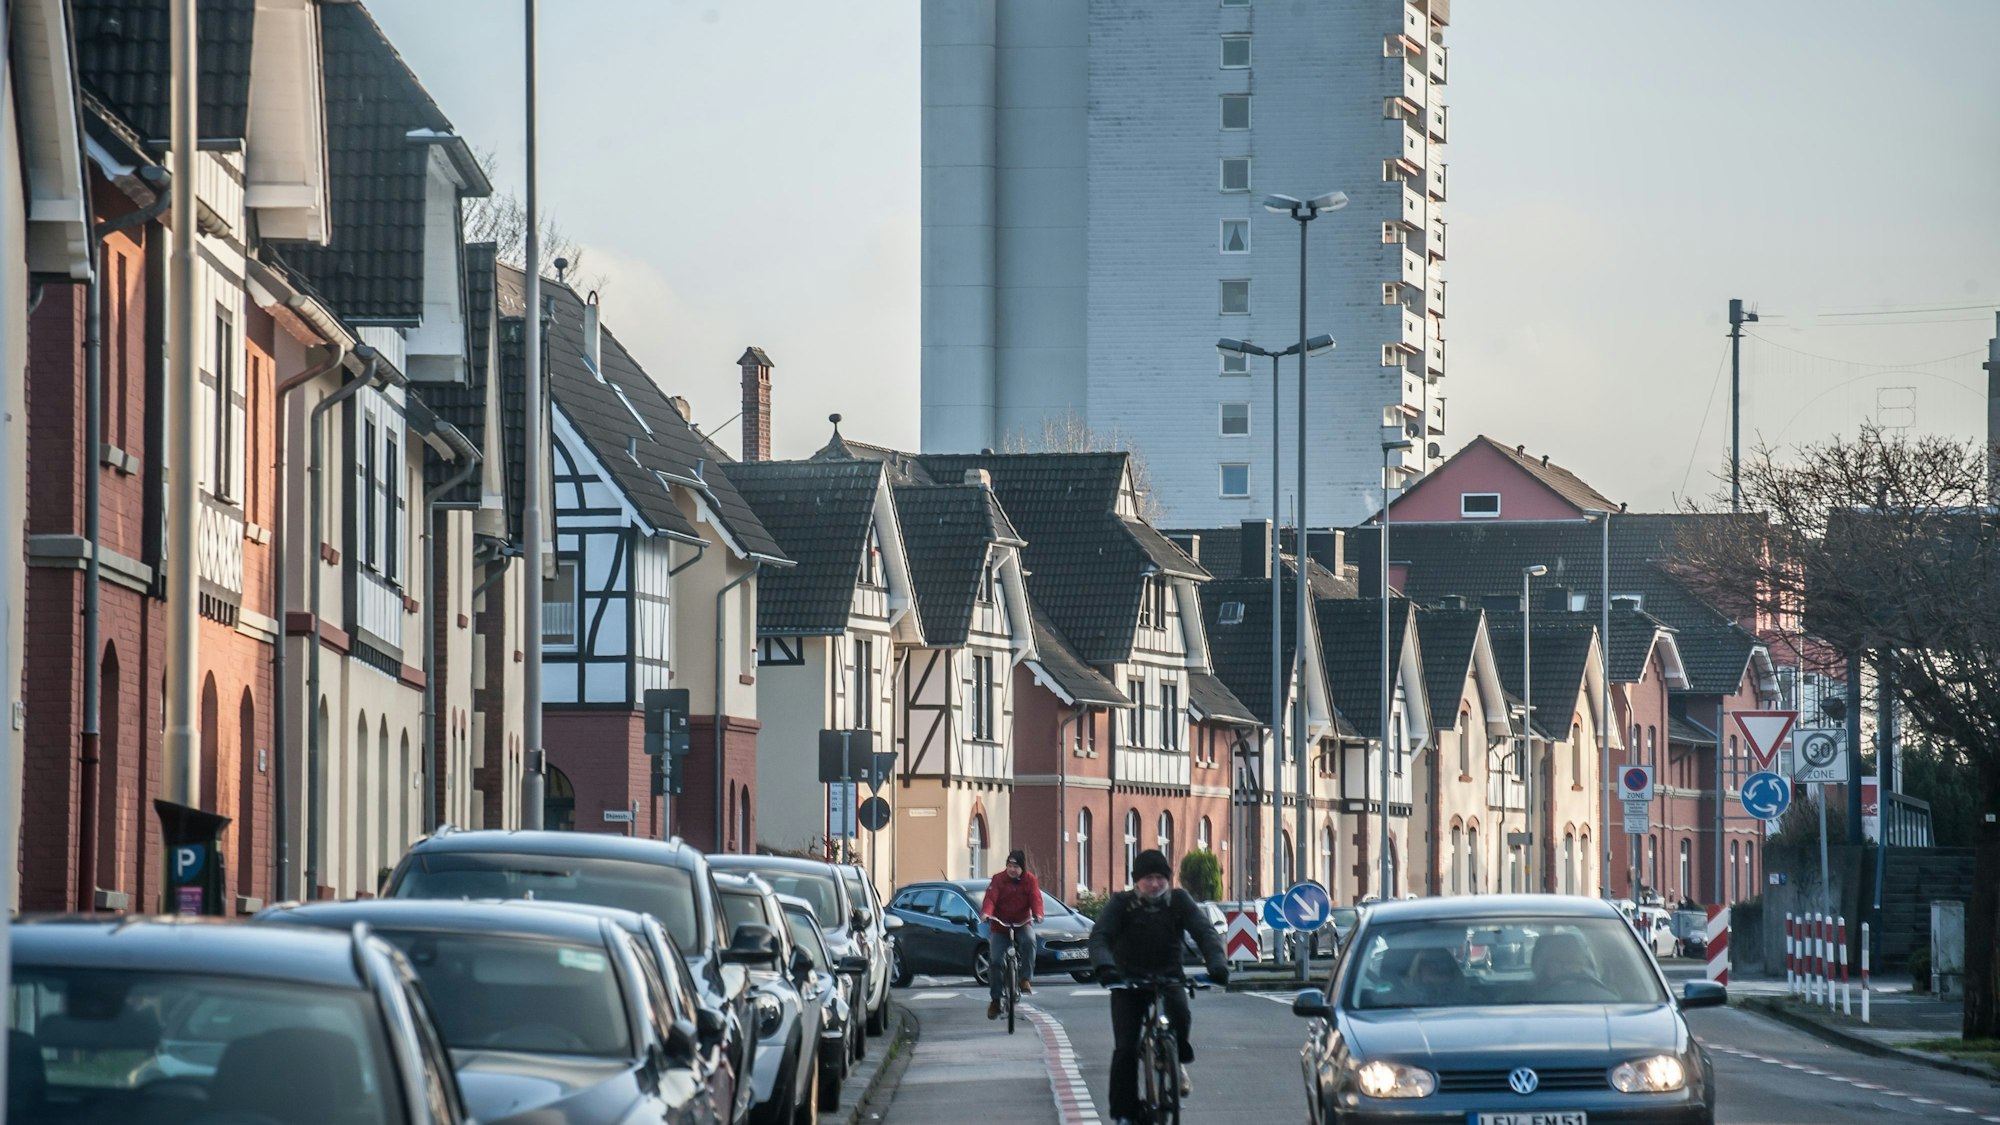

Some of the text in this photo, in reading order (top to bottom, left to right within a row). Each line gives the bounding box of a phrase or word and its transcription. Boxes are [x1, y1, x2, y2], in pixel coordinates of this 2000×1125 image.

[1809, 742, 1831, 759] 30
[1807, 769, 1835, 779] ZONE
[1626, 792, 1645, 800] ZONE
[176, 848, 197, 878] P
